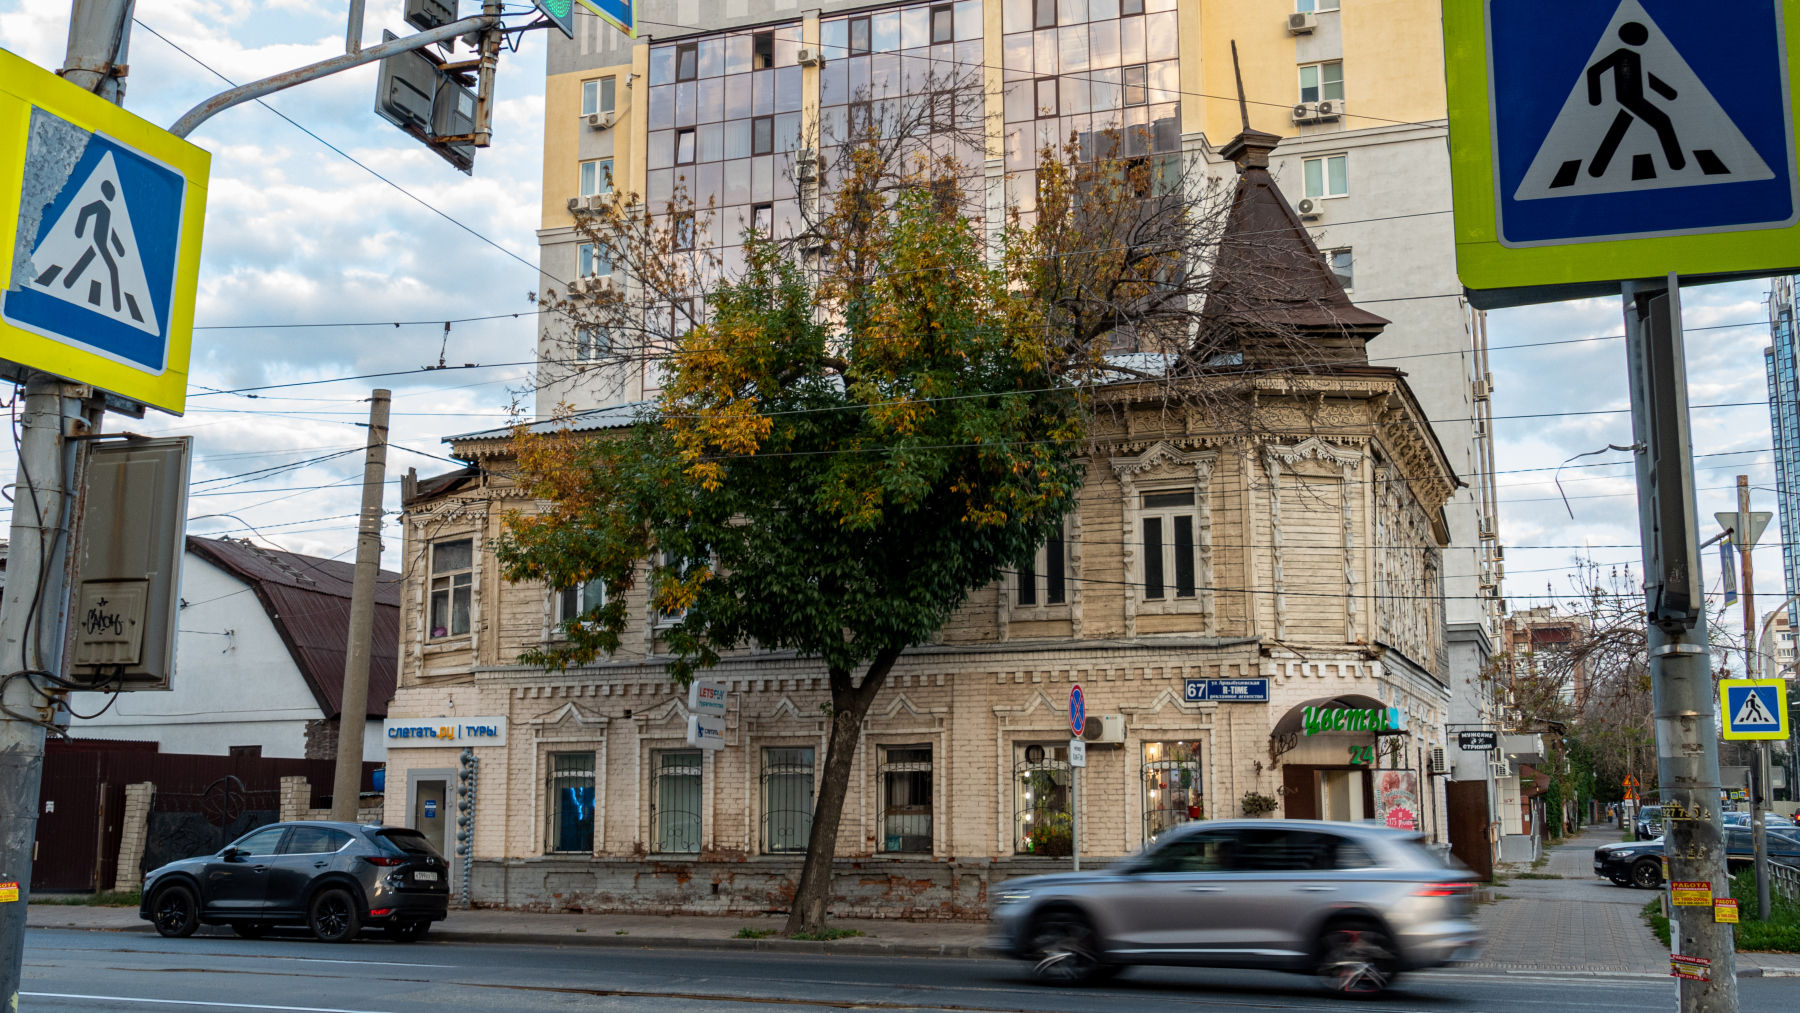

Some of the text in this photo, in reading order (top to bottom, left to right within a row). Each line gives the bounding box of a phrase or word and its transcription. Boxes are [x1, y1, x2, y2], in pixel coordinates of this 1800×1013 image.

[1187, 683, 1206, 697] 67
[1222, 686, 1248, 694] R-TIME
[1303, 706, 1388, 737] Цветы
[1350, 745, 1375, 765] 24
